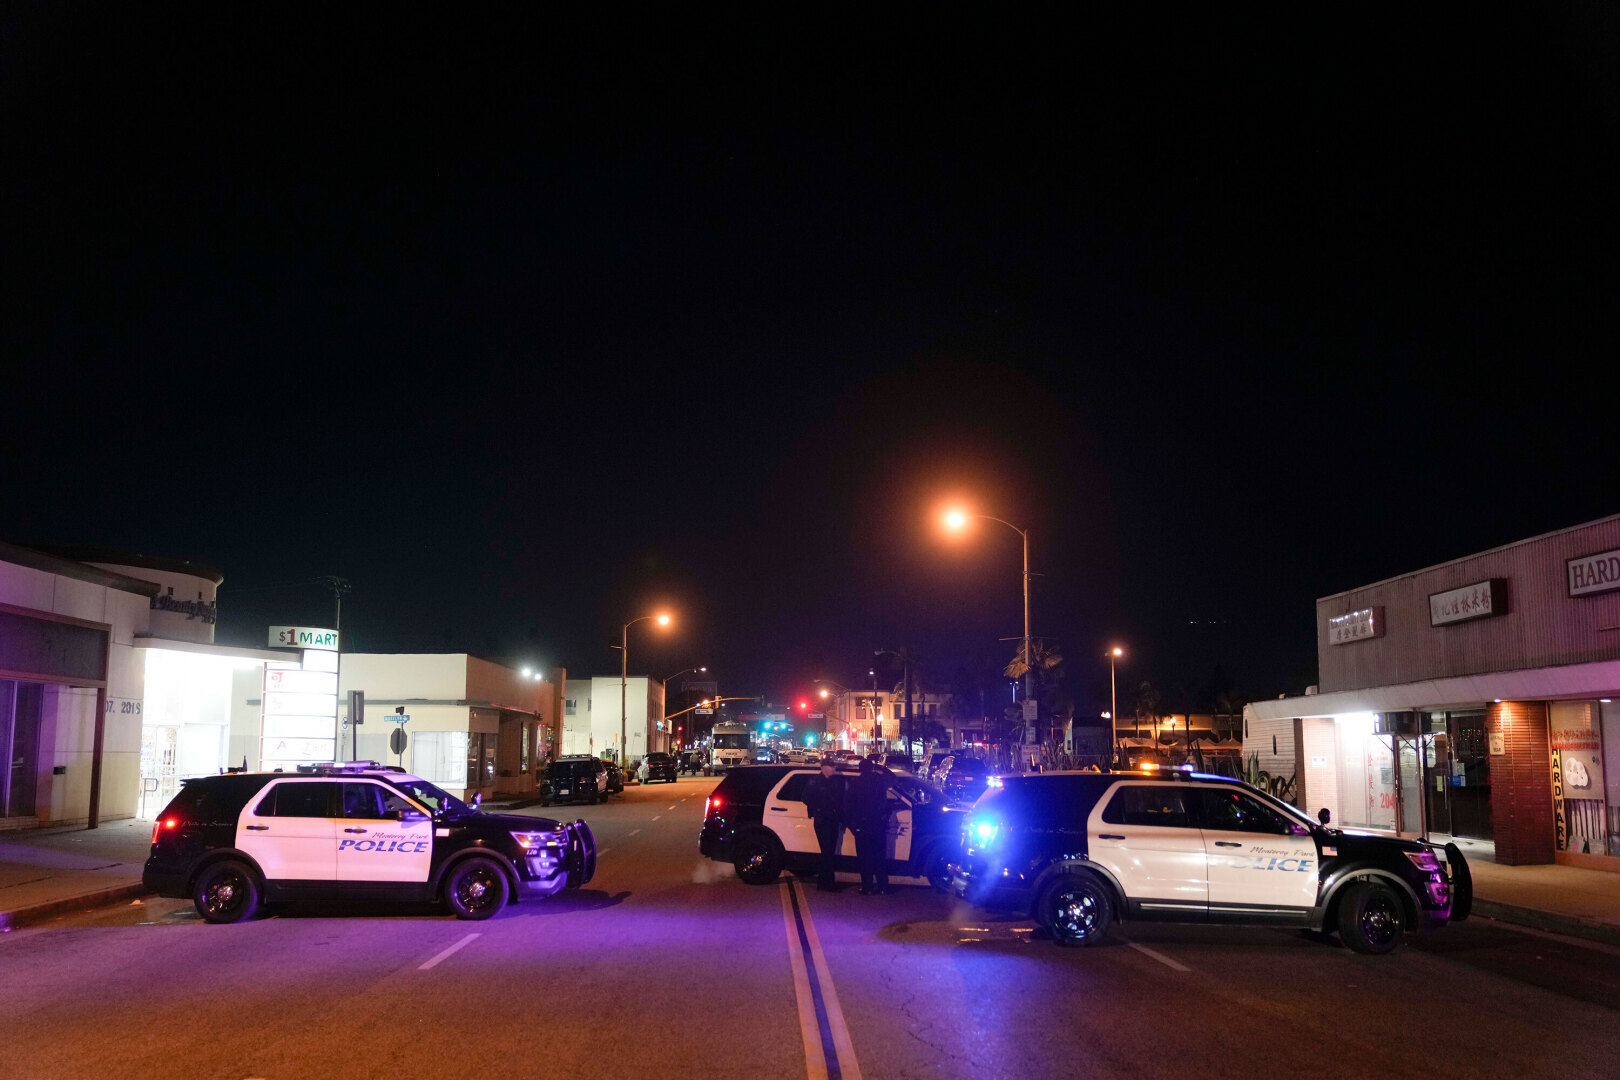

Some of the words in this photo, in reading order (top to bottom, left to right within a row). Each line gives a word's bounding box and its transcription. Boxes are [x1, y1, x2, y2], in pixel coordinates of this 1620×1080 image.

[300, 632, 337, 647] MART
[1551, 749, 1566, 851] HARDWARE
[372, 832, 406, 840] Monterey
[338, 840, 429, 853] POLICE
[1250, 846, 1289, 856] Monterey
[1293, 849, 1315, 857] Park
